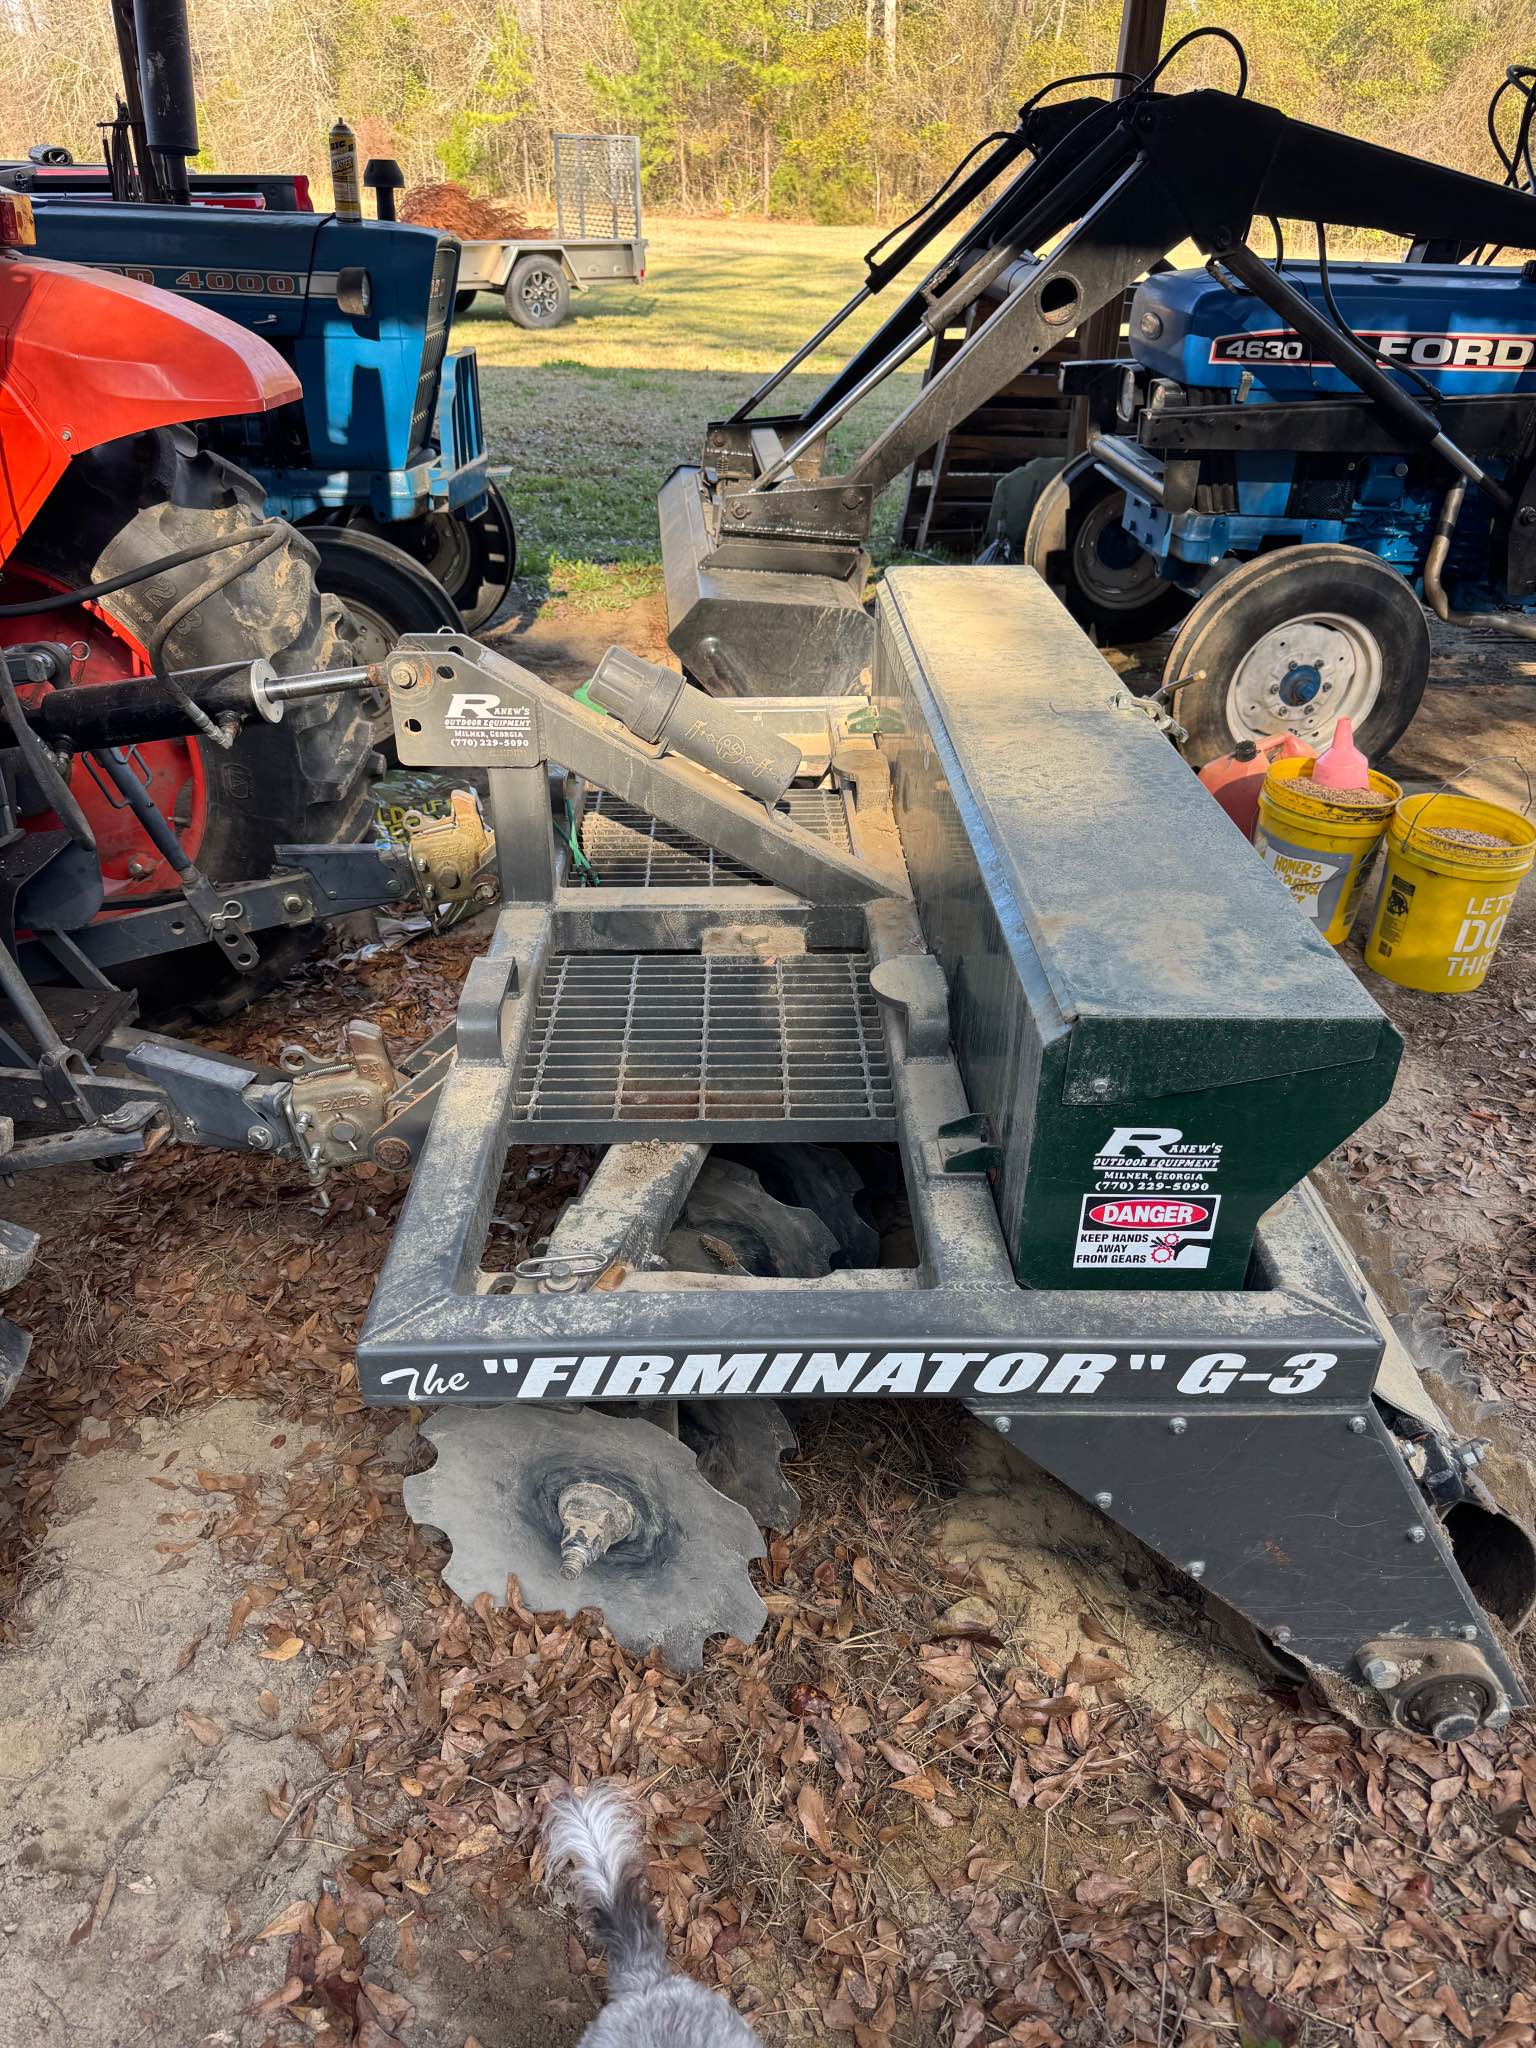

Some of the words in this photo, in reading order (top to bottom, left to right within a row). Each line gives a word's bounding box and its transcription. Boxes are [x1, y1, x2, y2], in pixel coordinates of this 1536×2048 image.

[175, 271, 295, 294] 4000
[1225, 340, 1304, 360] 4630
[1376, 336, 1535, 367] FORD
[444, 718, 482, 727] OUTDOOR
[482, 719, 532, 728] EQUIPMENT
[450, 738, 478, 748] (770)
[479, 739, 530, 747] 229-5090
[1453, 914, 1508, 953] DO
[1094, 1127, 1224, 1157] RANEW'S
[1092, 1157, 1147, 1167] OUTDOOR
[1149, 1158, 1221, 1169] EQUIPMENT
[1095, 1181, 1134, 1192] (770)
[1136, 1182, 1210, 1191] 229-5090
[1102, 1205, 1194, 1223] DANGER
[1080, 1233, 1109, 1243] KEEP
[1112, 1233, 1149, 1243] HANDS
[1096, 1244, 1129, 1253] AWAY
[1076, 1254, 1108, 1264] FROM
[1110, 1254, 1147, 1264] GEARS
[380, 1363, 471, 1400] The
[1176, 1352, 1338, 1395] G-3
